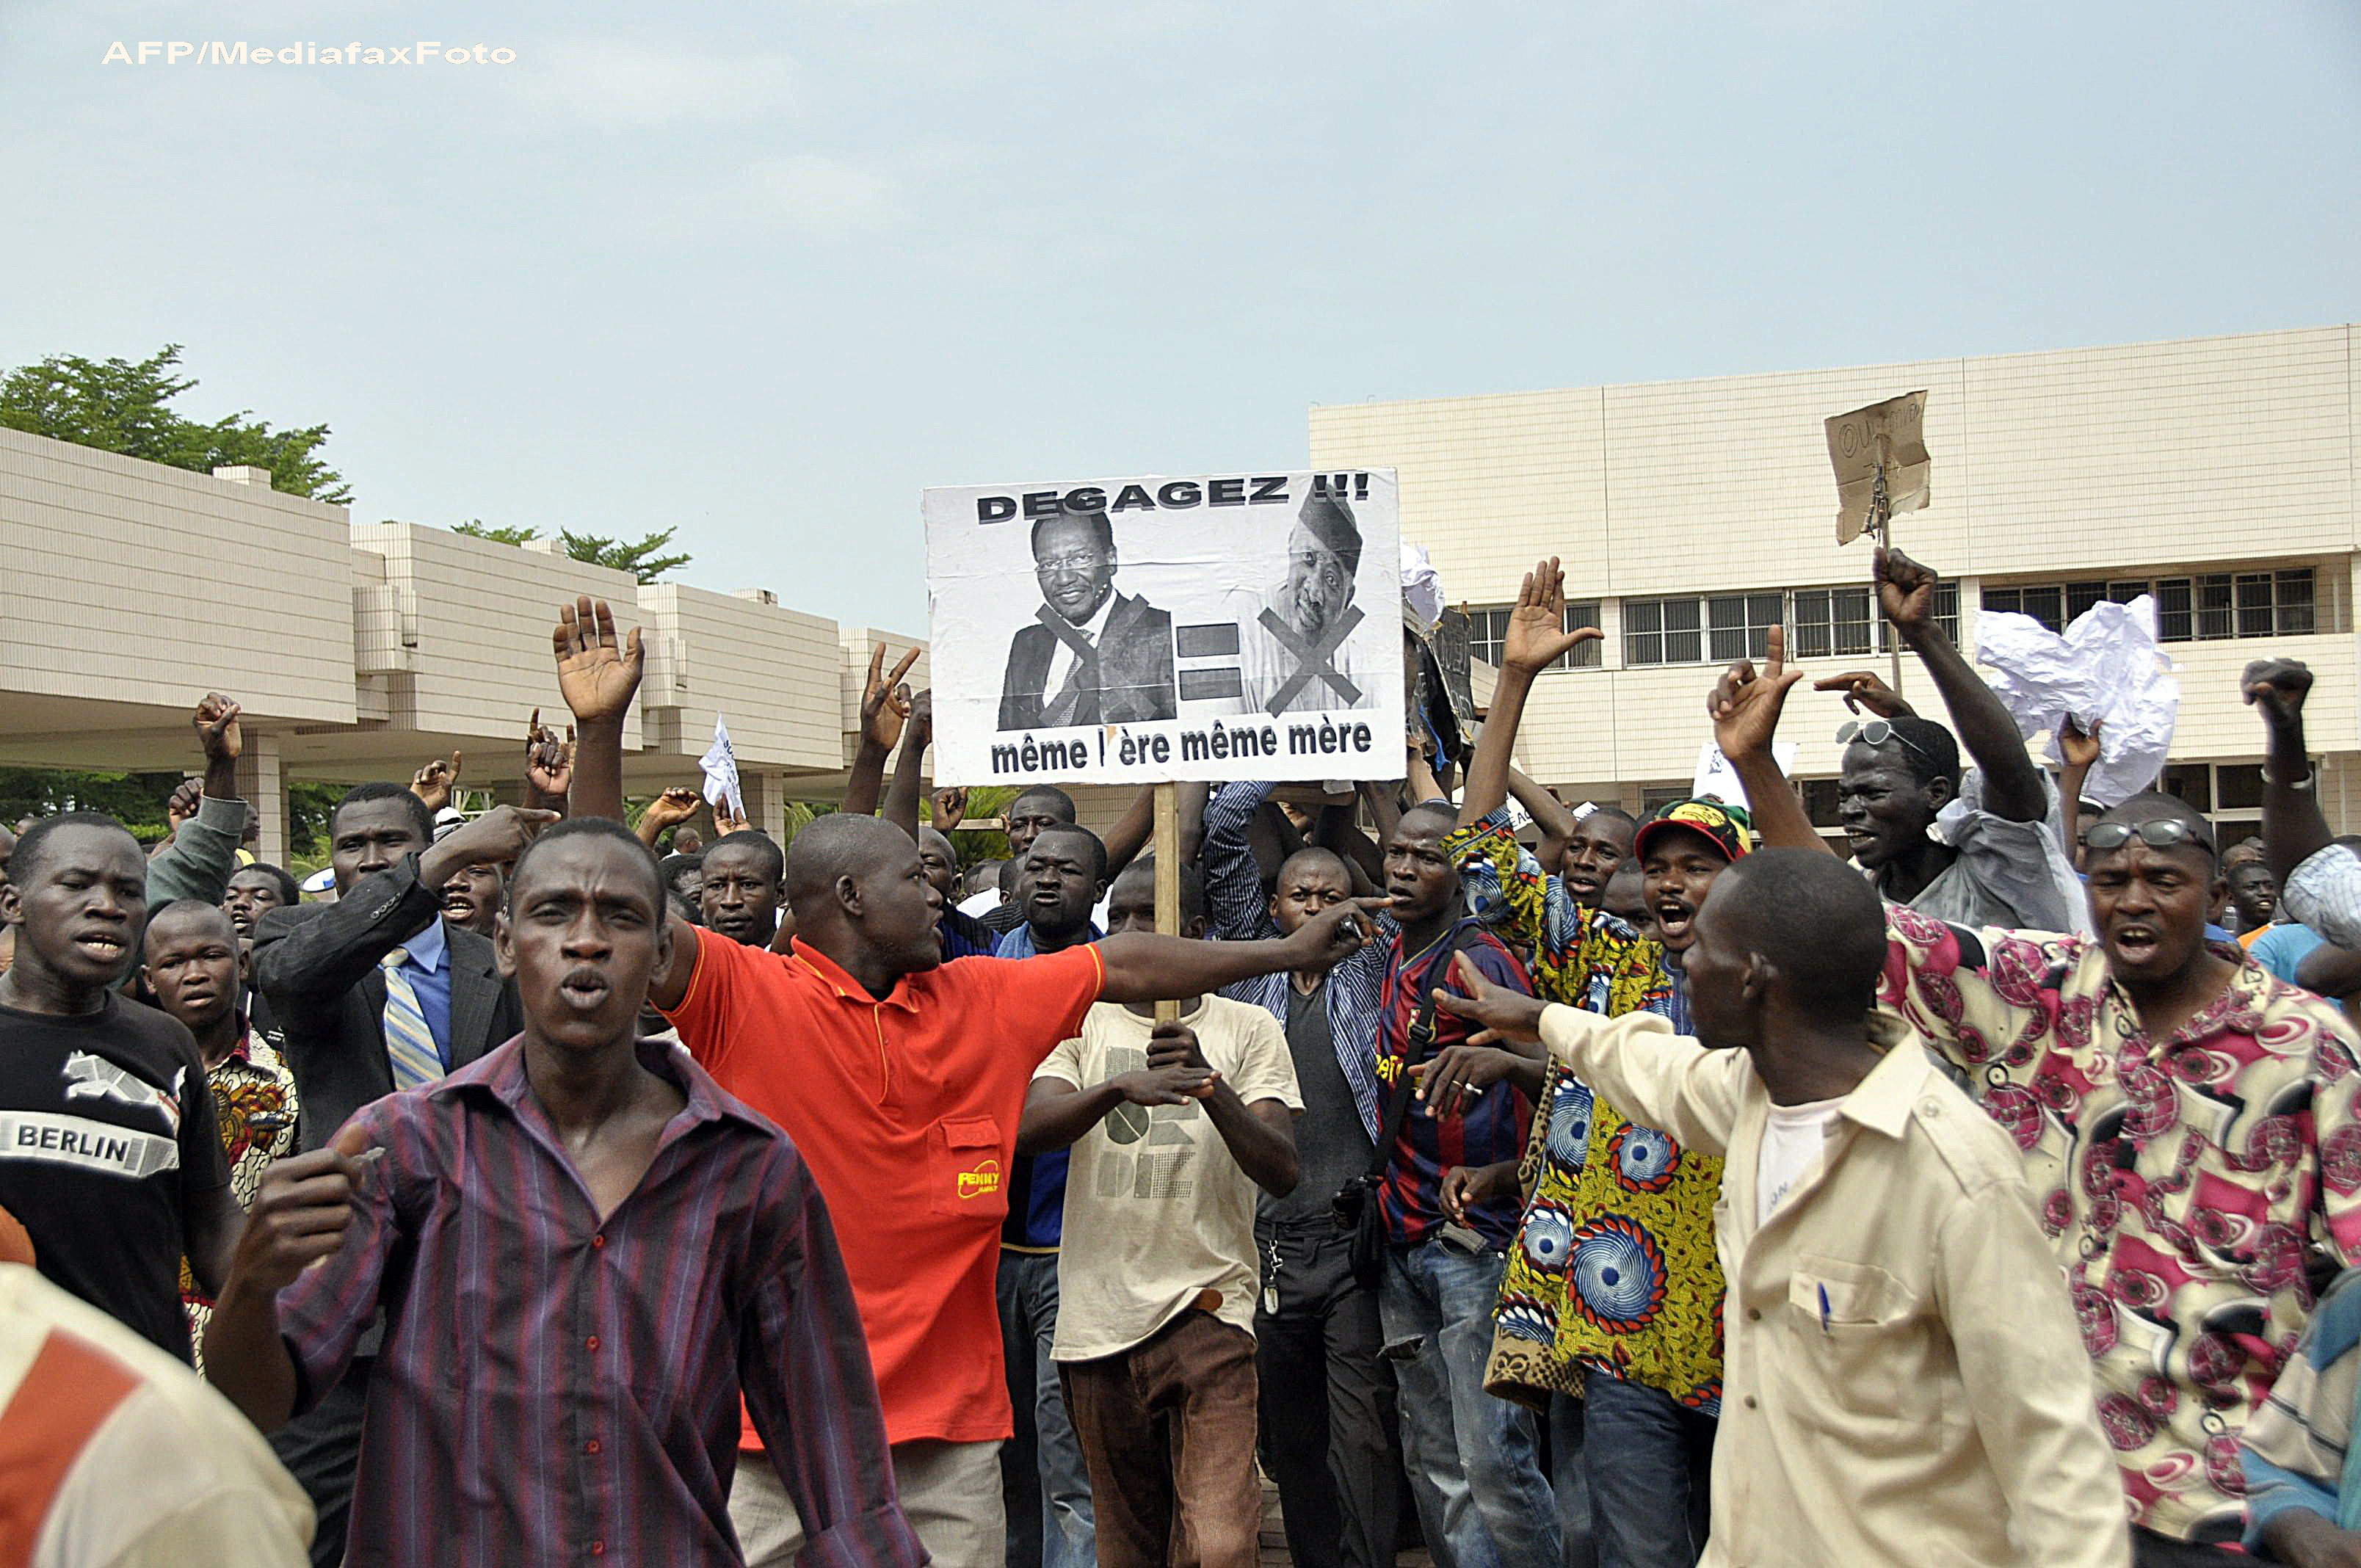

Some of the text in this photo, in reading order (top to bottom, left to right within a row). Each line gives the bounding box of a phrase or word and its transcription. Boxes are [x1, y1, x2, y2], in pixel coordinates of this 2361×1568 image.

[977, 476, 1289, 525] DEGAGEZ
[991, 732, 1088, 774] même
[1180, 719, 1277, 762] même
[1288, 713, 1372, 755] mère
[18, 1124, 129, 1162] BERLIN
[957, 1172, 1000, 1187] PENNY
